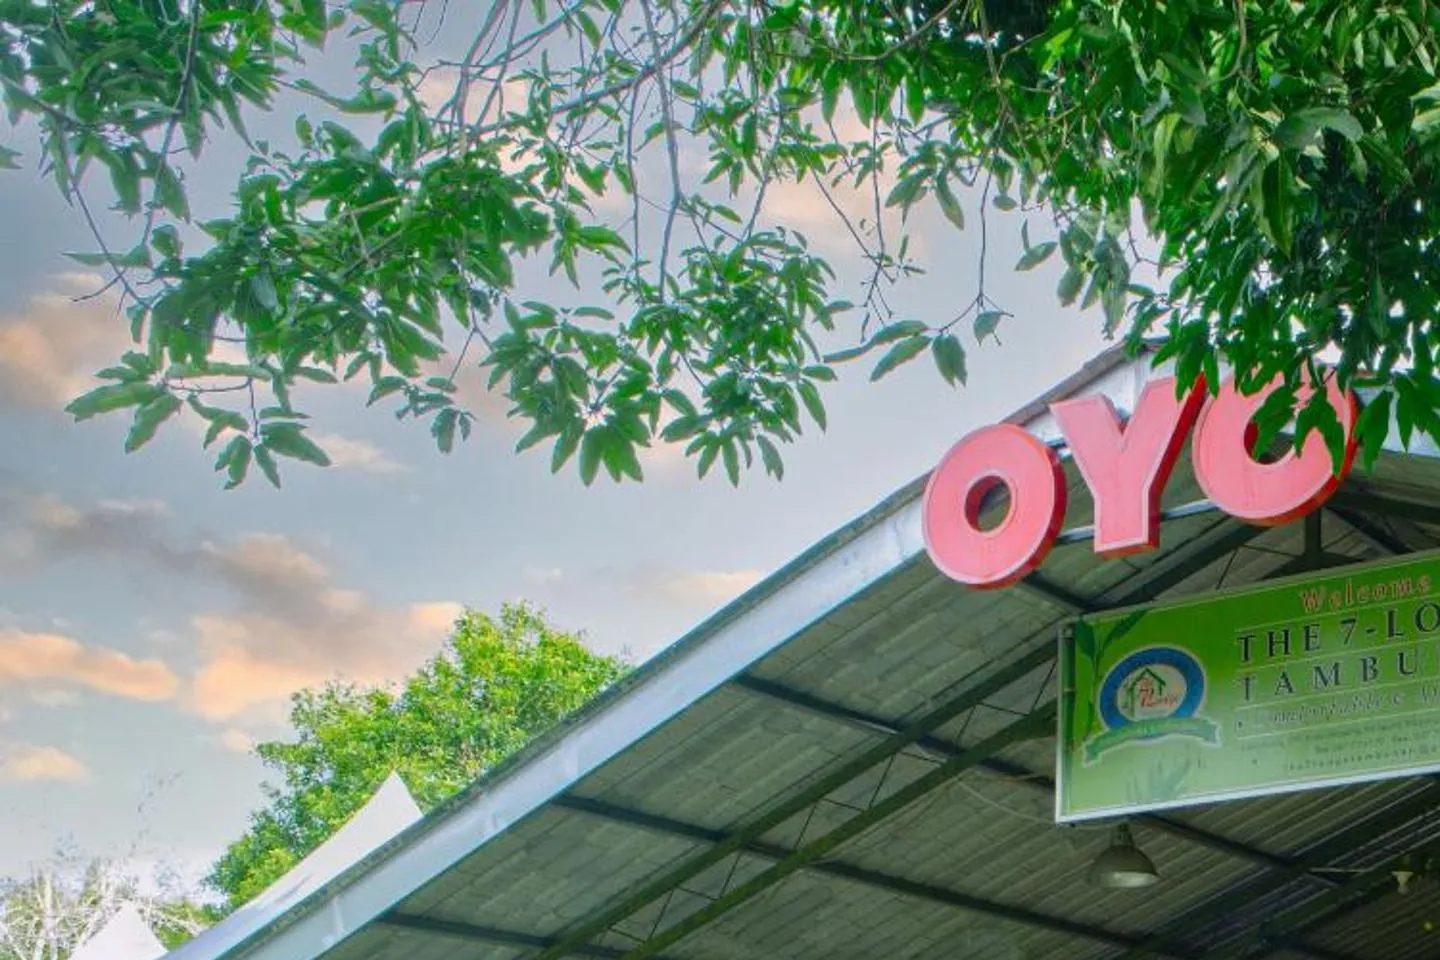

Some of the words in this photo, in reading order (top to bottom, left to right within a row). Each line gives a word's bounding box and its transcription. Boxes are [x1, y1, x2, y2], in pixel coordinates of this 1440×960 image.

[921, 366, 1360, 590] OYO
[1302, 574, 1431, 614] Welcome
[1237, 623, 1321, 662] THE
